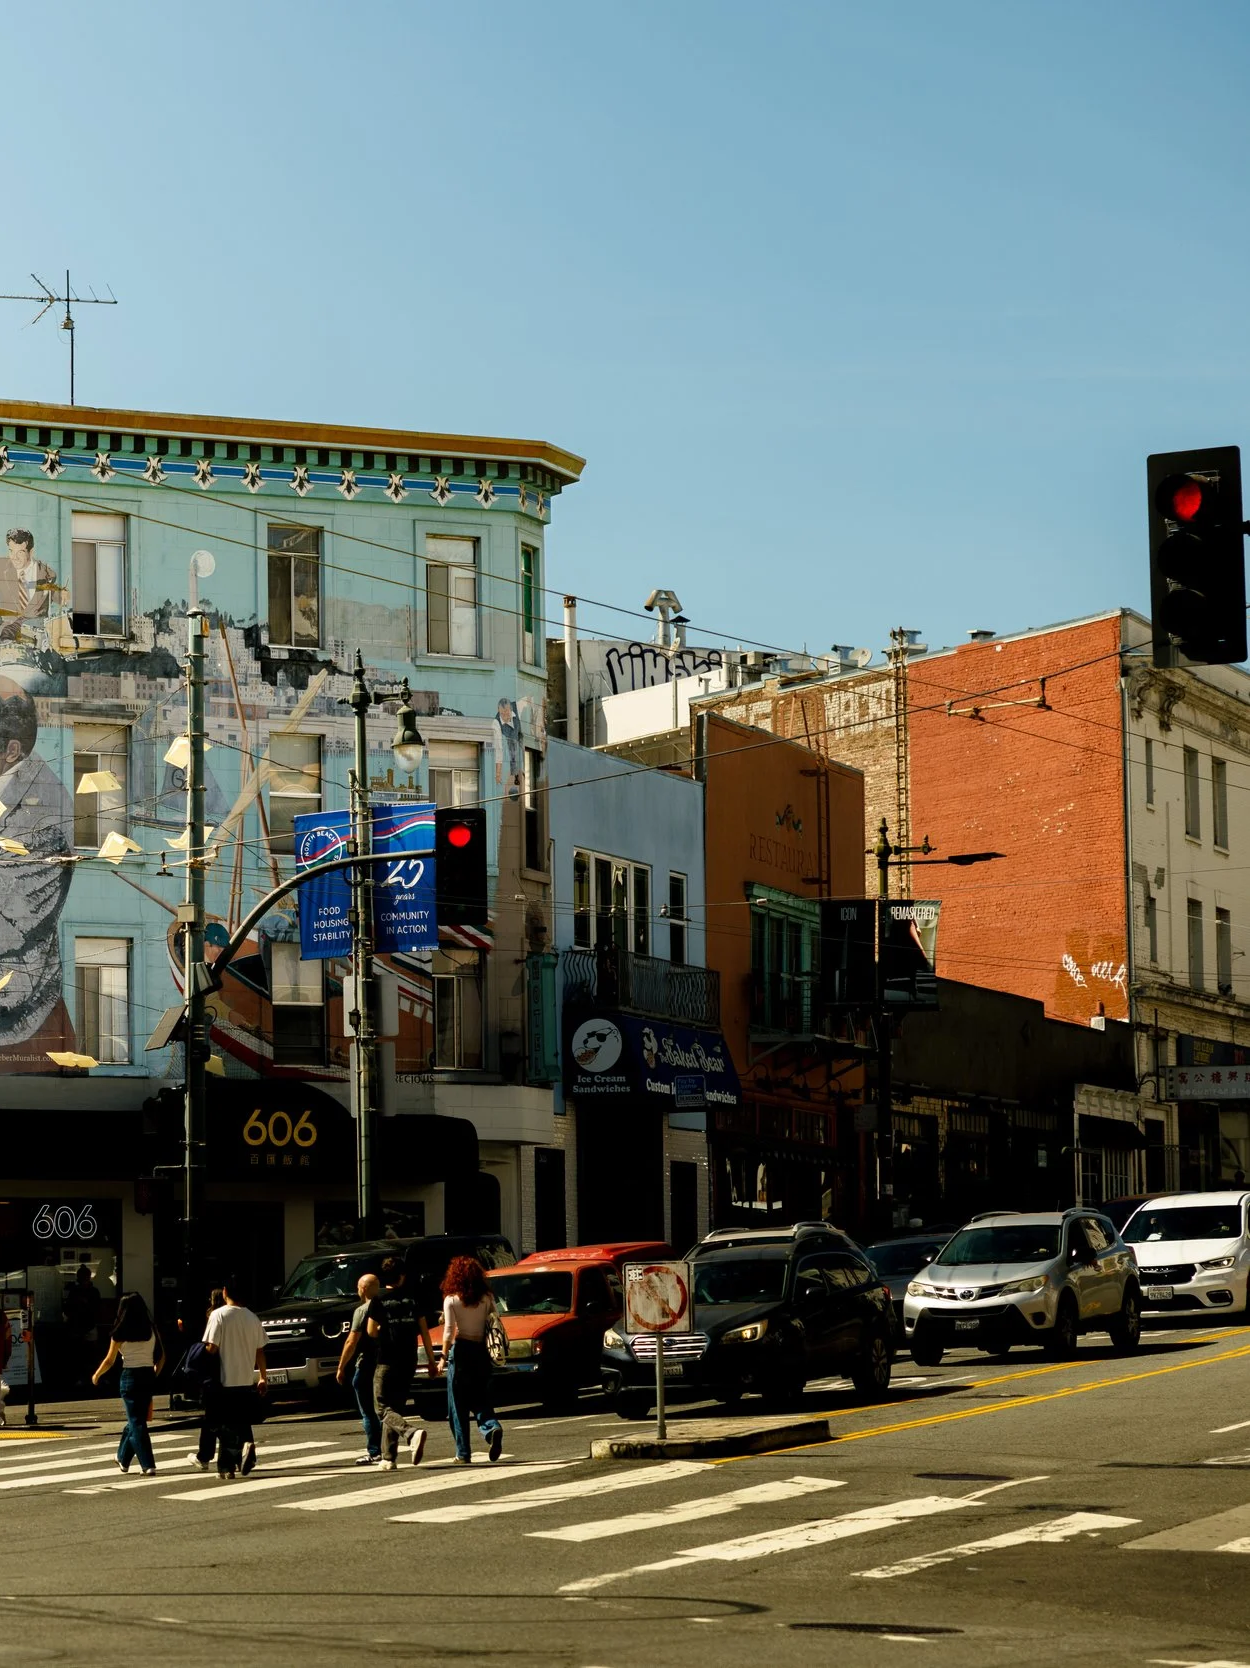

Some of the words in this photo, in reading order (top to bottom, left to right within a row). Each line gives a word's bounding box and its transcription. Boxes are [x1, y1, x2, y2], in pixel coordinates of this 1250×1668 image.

[317, 831, 336, 842] BEACH
[381, 859, 425, 889] 25
[393, 893, 416, 905] years
[318, 907, 341, 916] FOOD
[380, 910, 430, 922] COMMUNITY
[840, 907, 858, 920] ICON
[891, 906, 936, 920] REMASTERED
[313, 918, 349, 929] HOUSING
[386, 926, 395, 935] IN
[396, 924, 428, 934] ACTION
[313, 930, 351, 942] STABILITY
[662, 1038, 699, 1068] Baked
[700, 1048, 725, 1073] Bear
[577, 1075, 592, 1083] Ice
[594, 1074, 626, 1083] Cream
[572, 1083, 631, 1093] Sandwiches
[646, 1078, 670, 1095] Custom
[705, 1089, 737, 1104] andwiches
[243, 1109, 317, 1147] 606
[32, 1204, 98, 1239] 606
